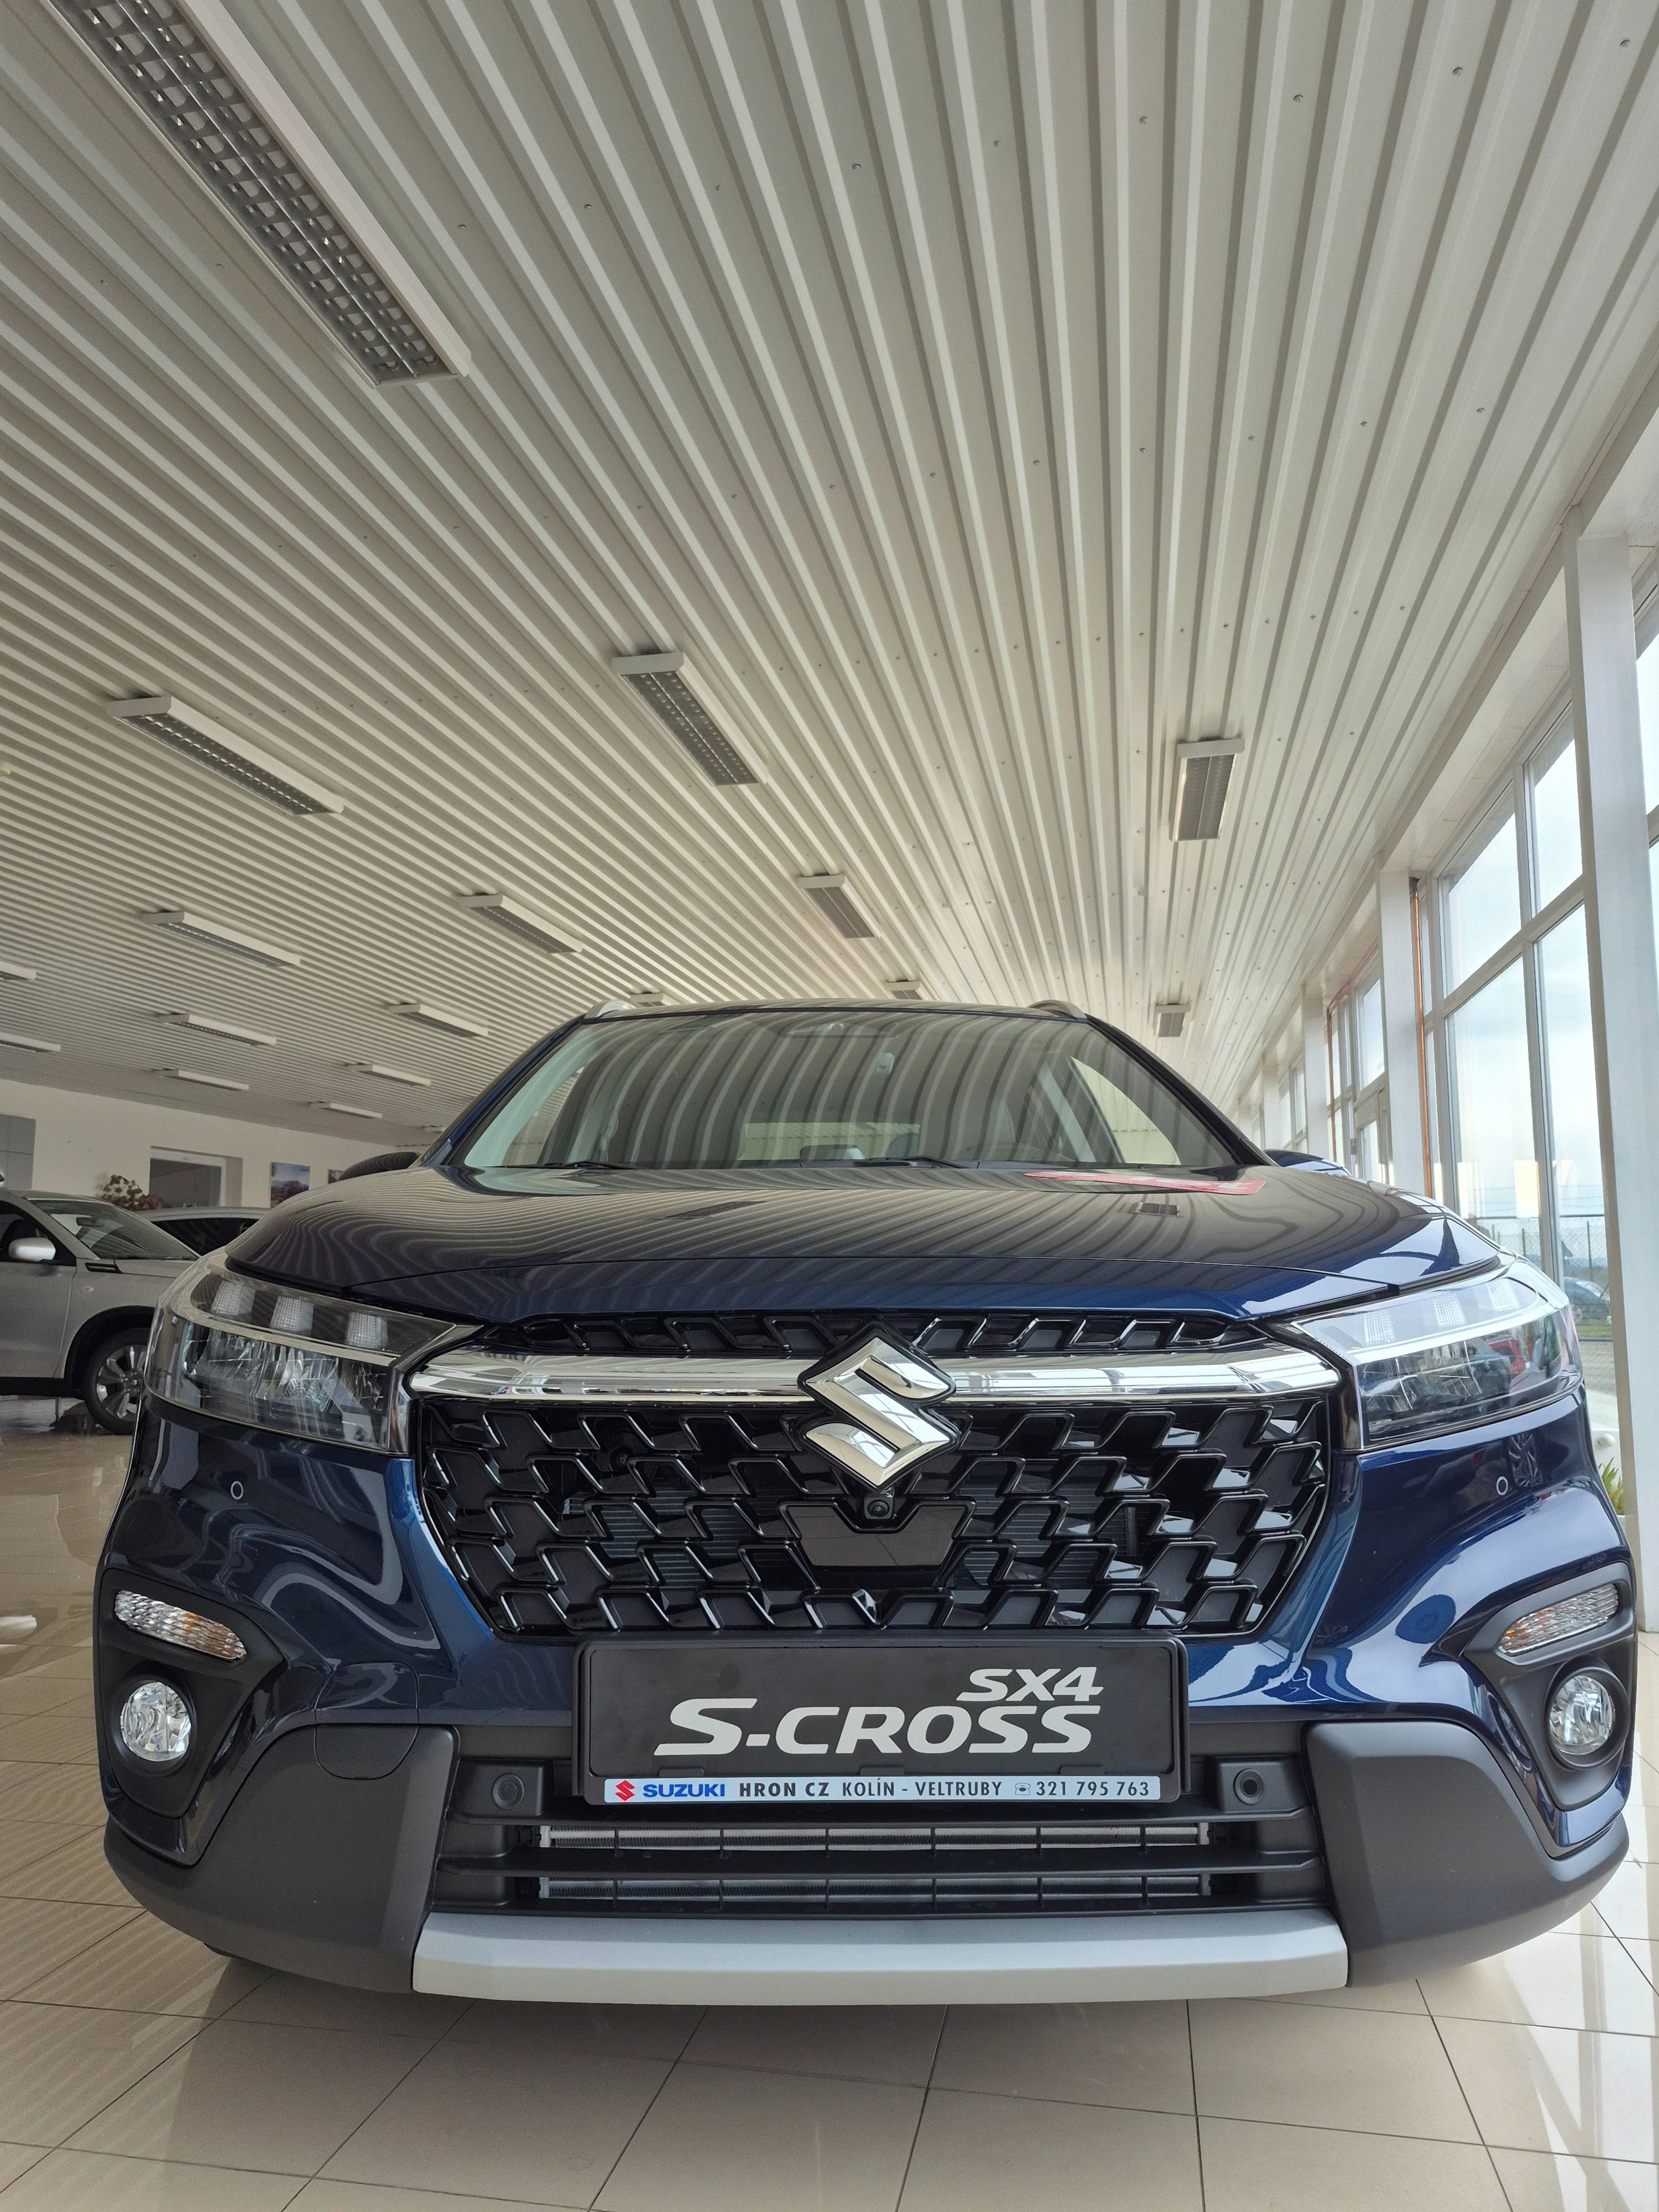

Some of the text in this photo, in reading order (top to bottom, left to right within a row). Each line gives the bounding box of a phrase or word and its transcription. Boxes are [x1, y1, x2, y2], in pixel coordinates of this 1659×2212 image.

[956, 1666, 1104, 1702] SX4
[654, 1698, 1101, 1756] S-CROSS
[643, 1783, 725, 1798] SUZUKI
[739, 1782, 796, 1797] HRON
[805, 1782, 830, 1797] CZ
[842, 1777, 894, 1797] KOLÍN
[915, 1781, 1002, 1796] VELTRUBY
[1036, 1781, 1066, 1796] 321
[1077, 1781, 1108, 1796] 795
[1117, 1781, 1149, 1796] 763
